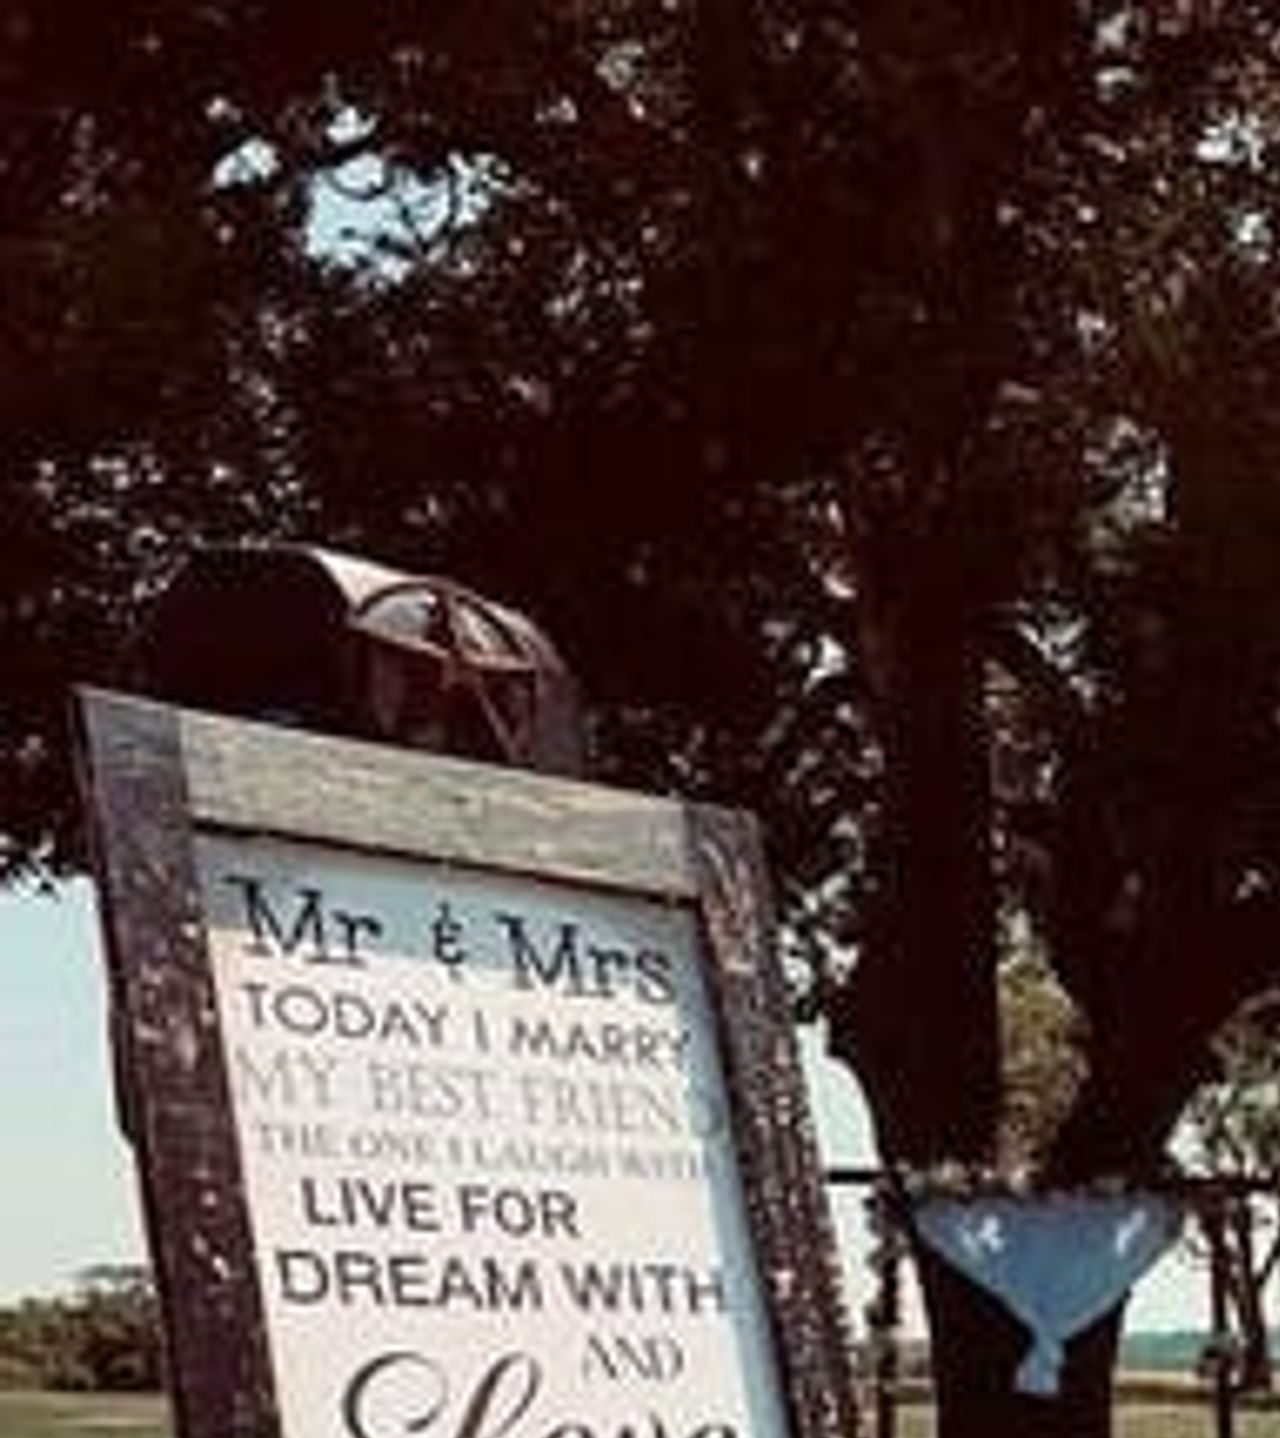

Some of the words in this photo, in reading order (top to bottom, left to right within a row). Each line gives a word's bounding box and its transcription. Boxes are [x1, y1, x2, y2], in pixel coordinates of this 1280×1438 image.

[226, 875, 382, 966] Mr
[432, 900, 468, 983] &
[495, 914, 679, 1006] Mrs
[241, 983, 450, 1047] TODAY
[474, 1009, 489, 1054] I
[510, 1016, 692, 1072] MARRY
[235, 1048, 337, 1107] MY
[369, 1061, 498, 1120] BEST
[256, 1121, 341, 1159] THE
[349, 1127, 428, 1165] ONE
[301, 1177, 441, 1233] LIVE
[457, 1184, 581, 1239] FOR
[274, 1249, 545, 1312] DREAM
[558, 1263, 730, 1315] WITH
[580, 1336, 685, 1383] AND
